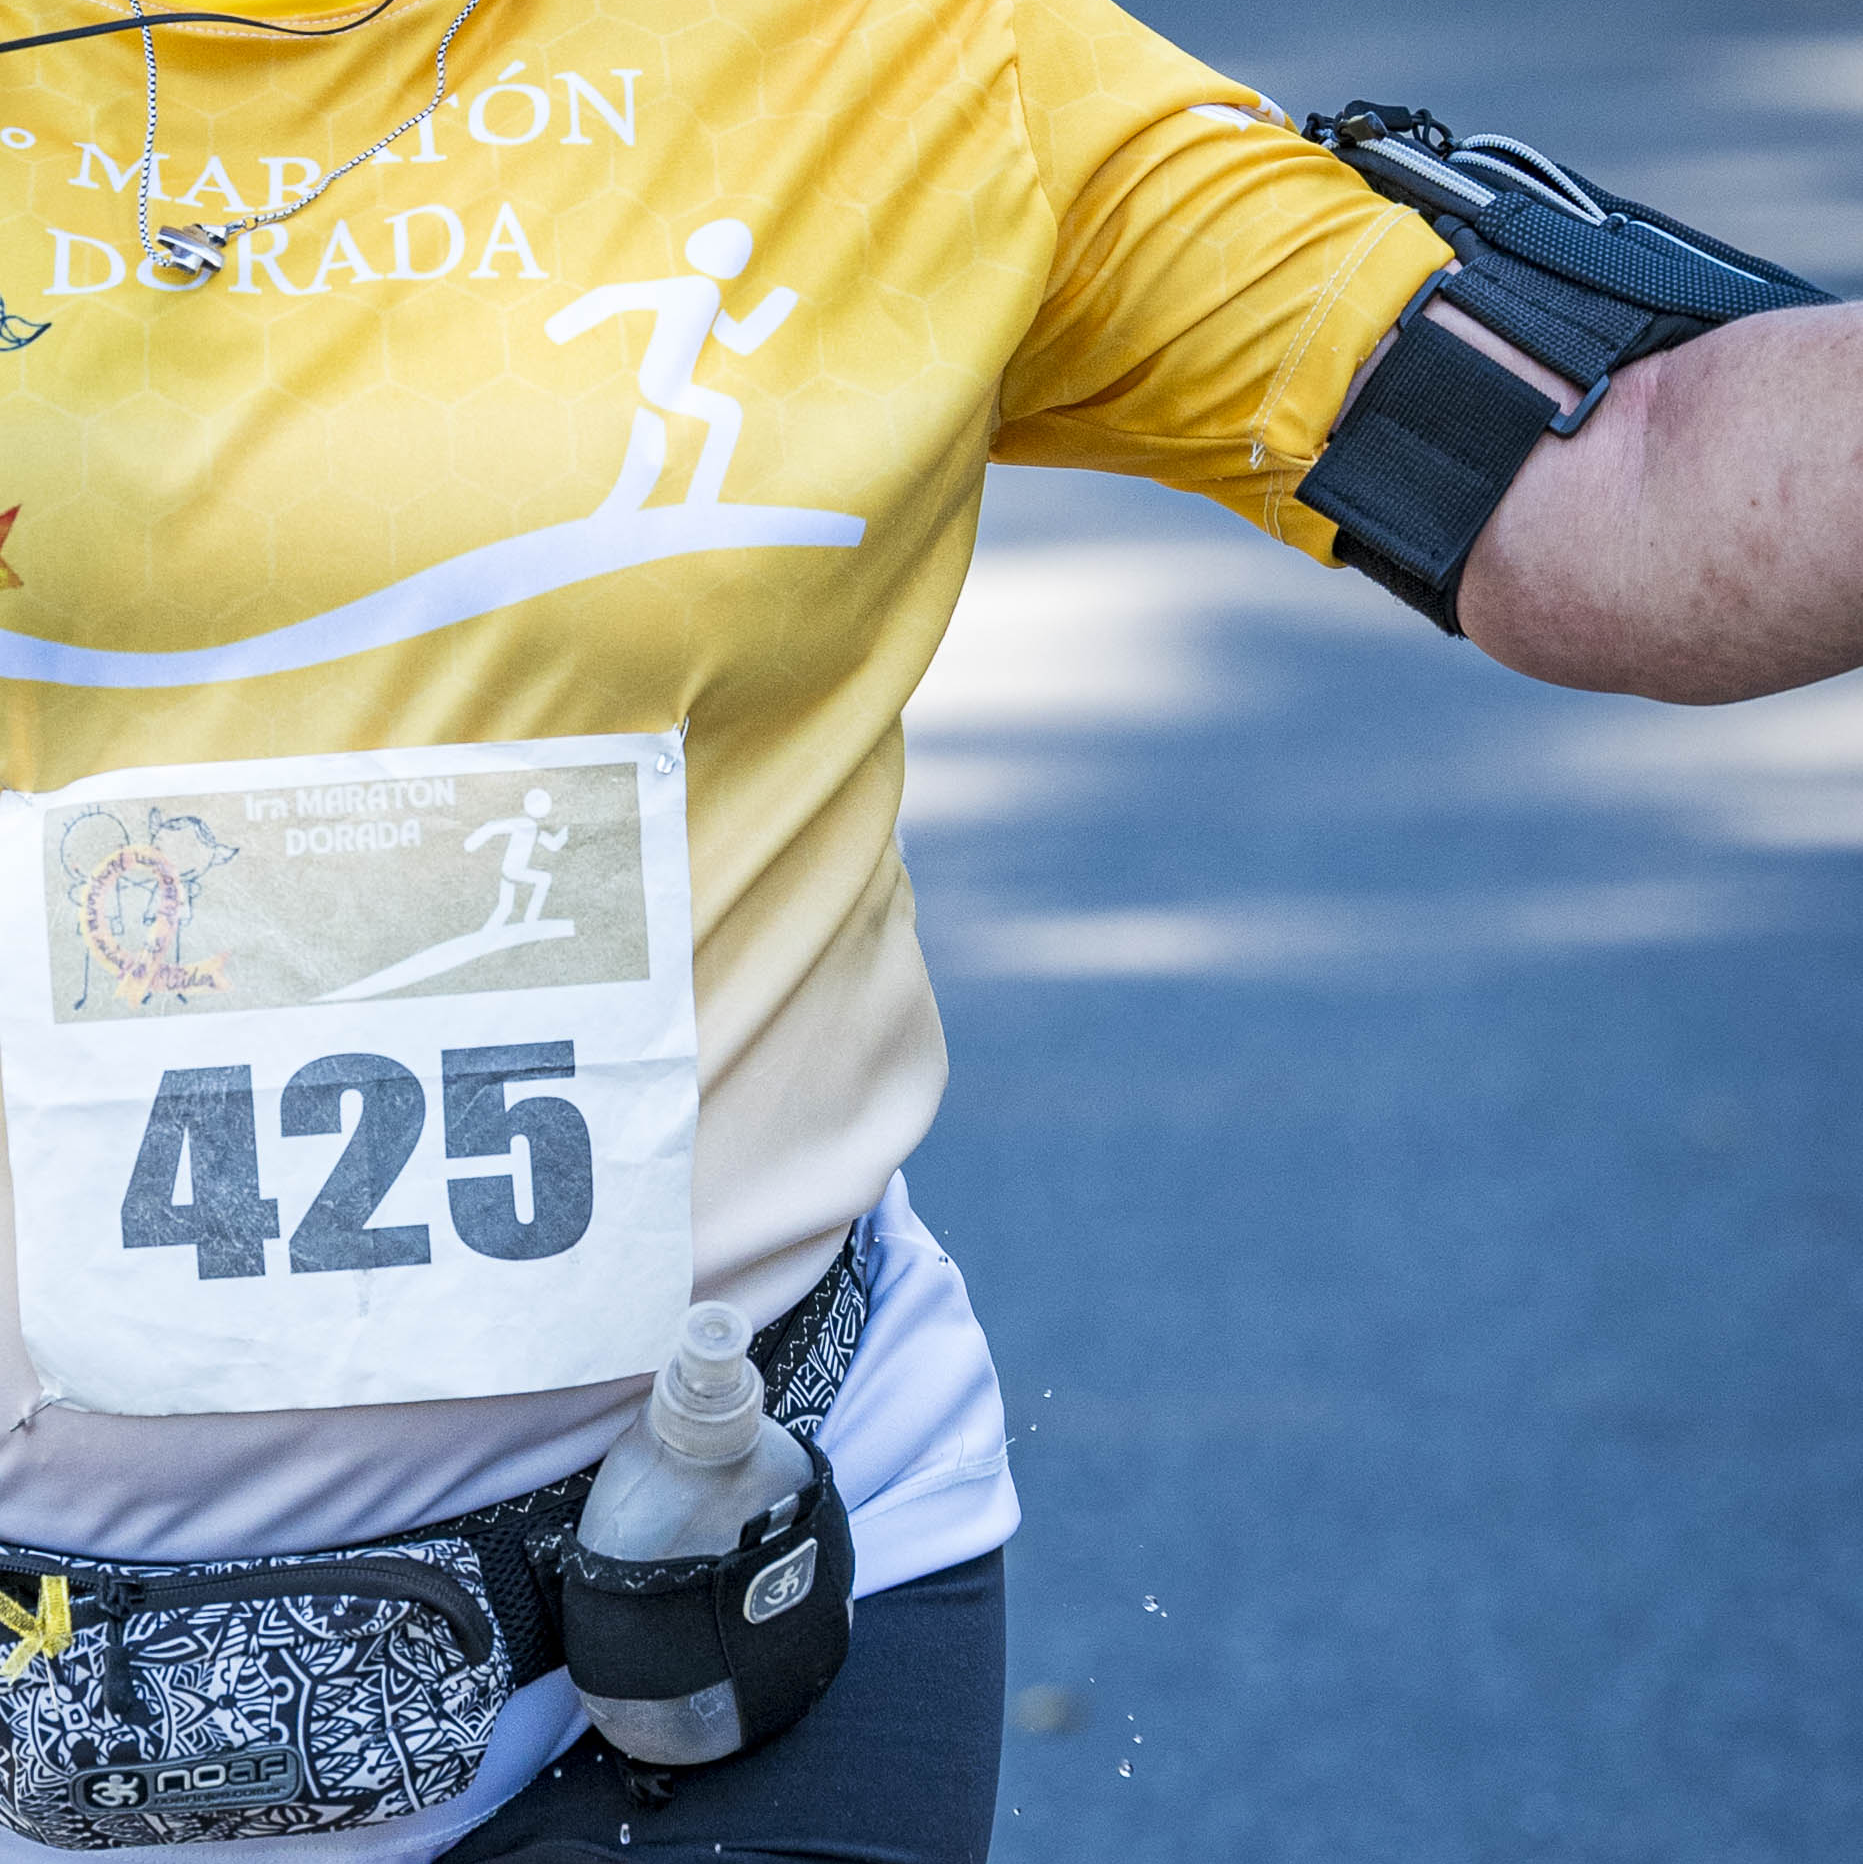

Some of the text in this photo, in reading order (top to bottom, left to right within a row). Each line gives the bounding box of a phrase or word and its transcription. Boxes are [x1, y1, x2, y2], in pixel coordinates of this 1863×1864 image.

[67, 58, 644, 213] MARTÓN
[284, 818, 422, 857] DORADA
[121, 1039, 594, 1282] 425
